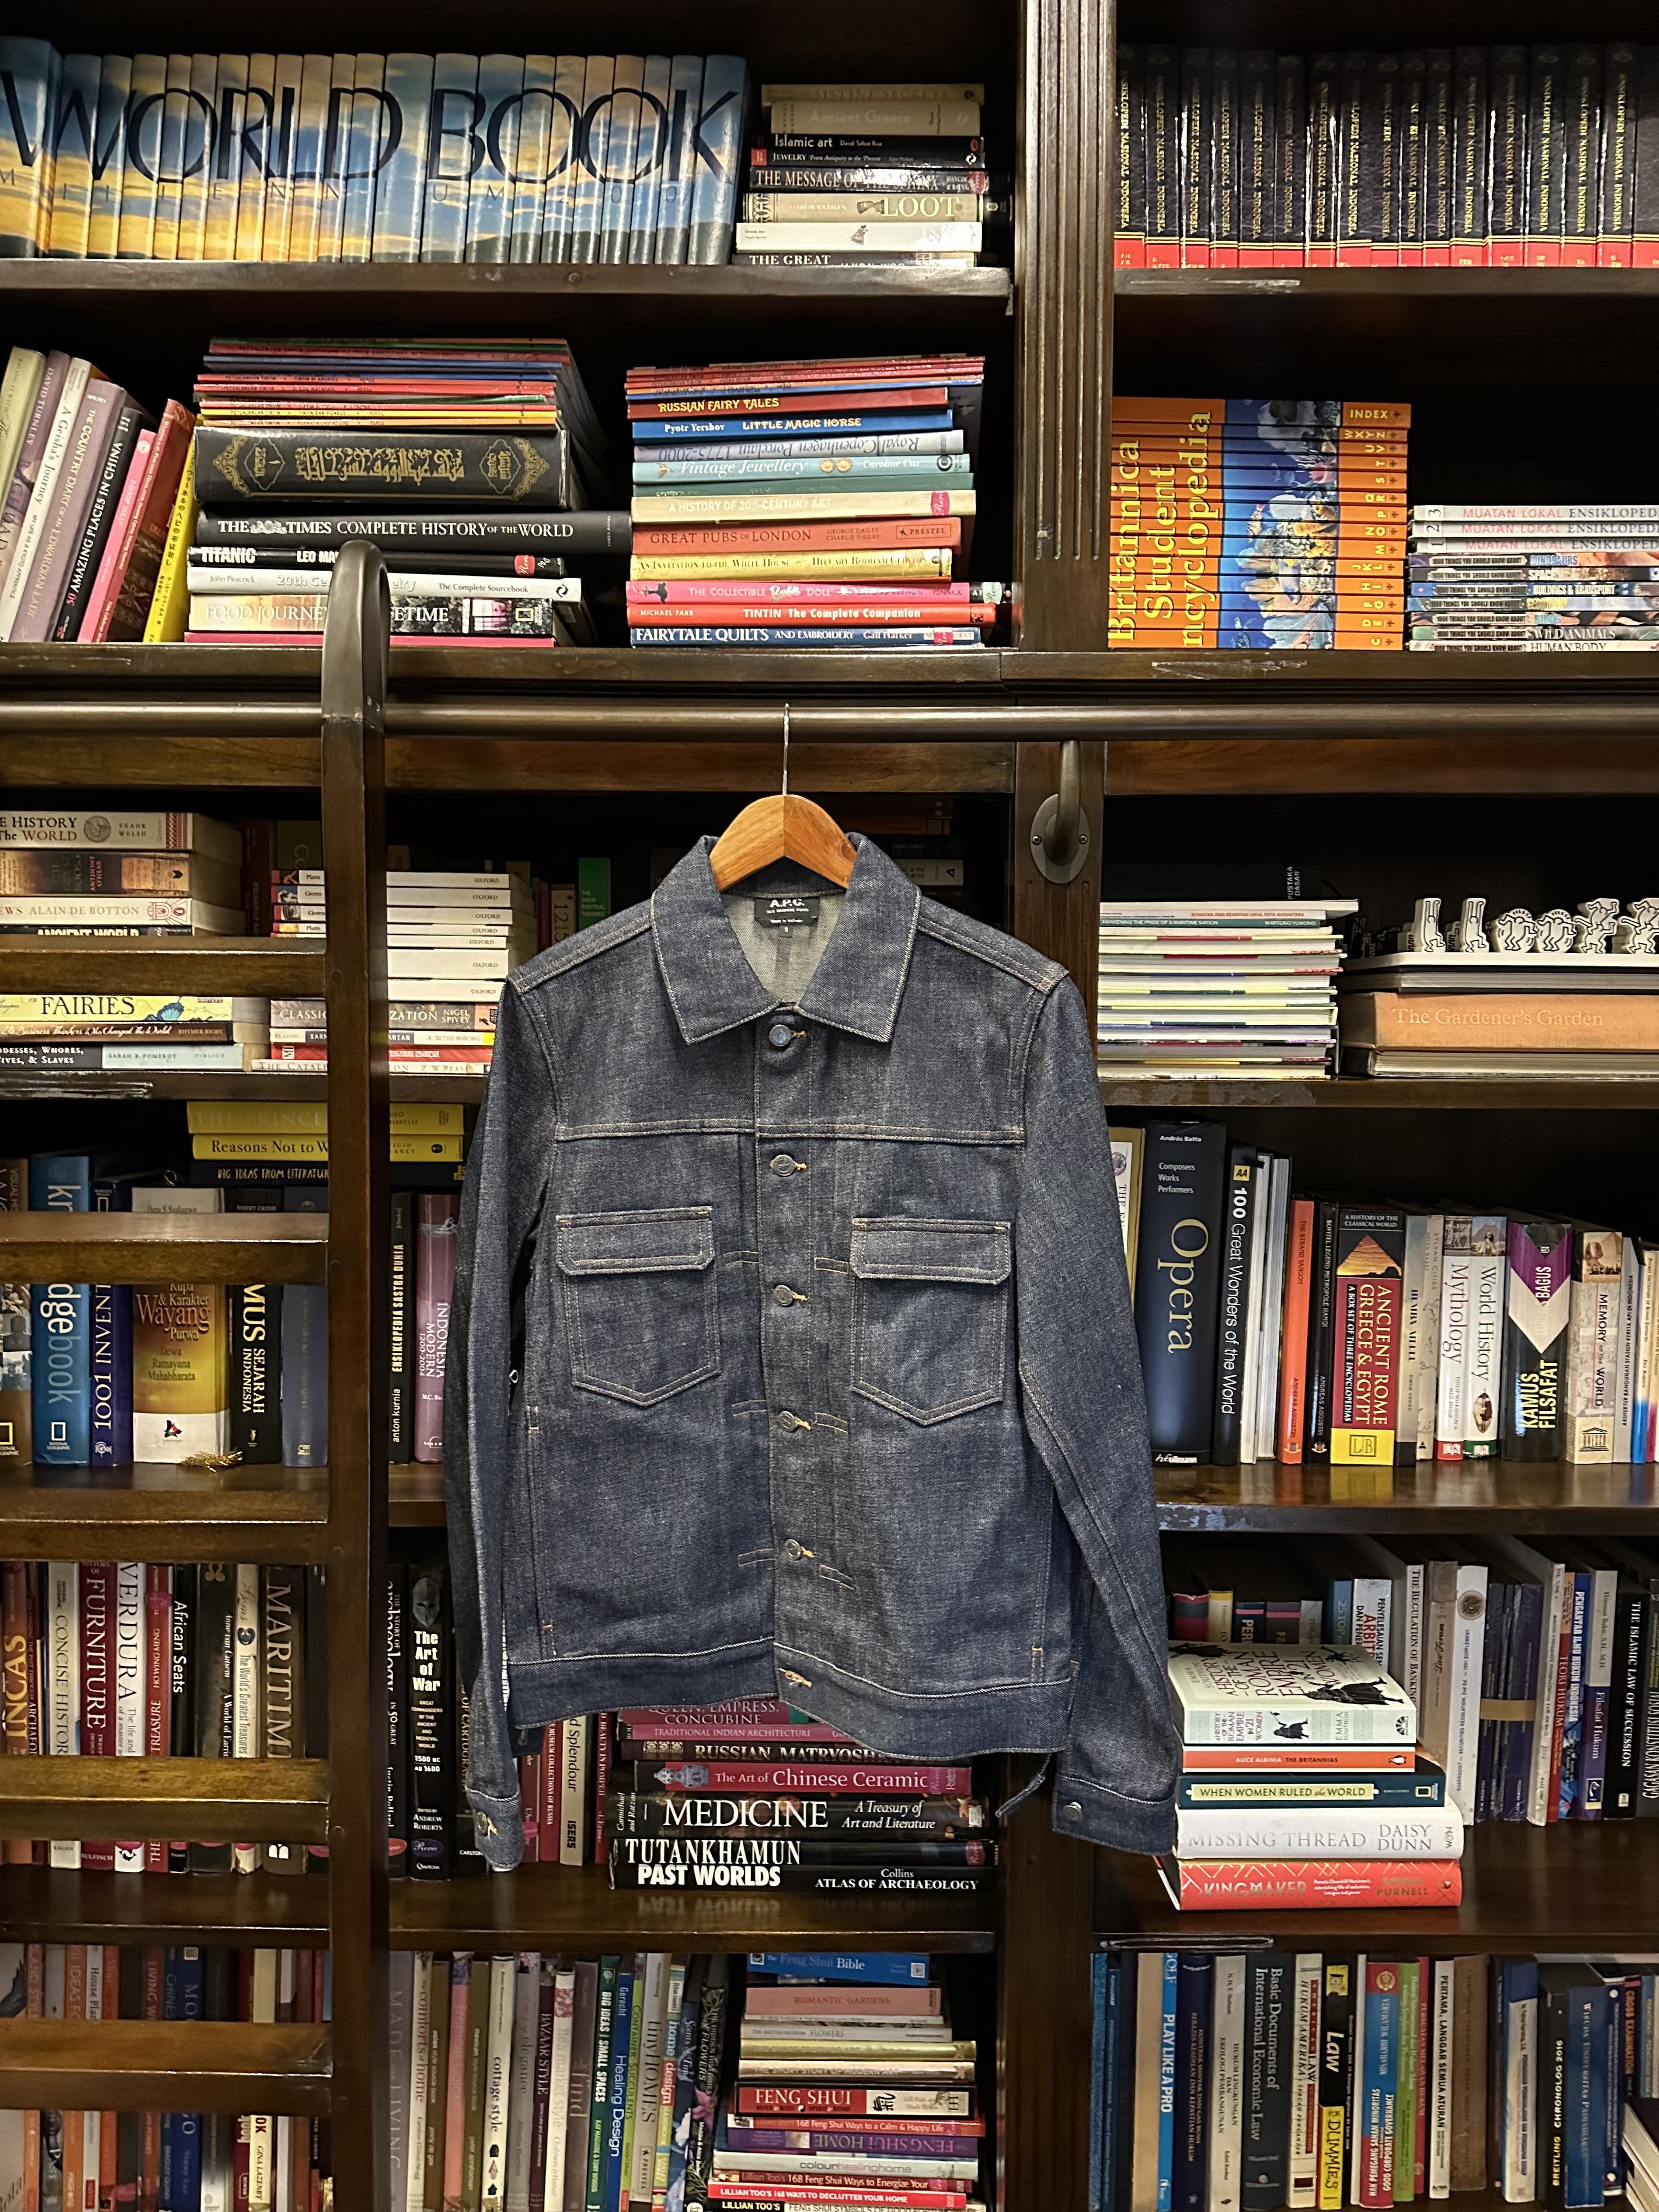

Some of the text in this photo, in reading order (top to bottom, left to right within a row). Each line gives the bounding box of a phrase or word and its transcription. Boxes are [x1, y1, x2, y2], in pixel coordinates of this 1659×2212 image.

[1, 71, 740, 185] WORLD BOOK
[775, 135, 833, 148] Islamic art
[773, 153, 806, 161] JEWELRY
[756, 170, 840, 188] THE MESSAGE
[1613, 137, 1624, 231] NASIONAL INDONESIA
[881, 197, 960, 218] LOOT
[749, 255, 831, 265] THE GREAT
[657, 398, 779, 413] RUSSIAN FAIRY TALES
[1349, 409, 1388, 419] INDEX
[665, 422, 725, 434] Pyotr Yershov
[742, 417, 862, 431] LITTLE MAGIC HORSE
[35, 407, 71, 504] A Geisha's Journey
[659, 433, 921, 462] Royal Copenhagen Porcelain 1775-2000
[680, 459, 809, 477] Vintage Jewellery
[71, 442, 123, 593] AMAZING PLACES IN CHINA
[1463, 508, 1563, 518] MUATAN LOKAL
[218, 520, 249, 533] THE
[286, 521, 332, 534] TIMES
[337, 521, 417, 536] COMPLETE
[421, 522, 487, 536] HISTORY
[518, 523, 574, 537] WORLD
[650, 533, 697, 544] GREAT
[702, 531, 738, 543] PUBS
[752, 530, 811, 542] LONDON
[1108, 440, 1139, 641] Britannica
[1144, 464, 1176, 619] Student
[200, 546, 316, 564] TITANIC LEO
[453, 583, 486, 592] Complete
[744, 608, 921, 620] TINTIN The Complete Companion
[635, 628, 712, 642] FAIRYTALE
[715, 628, 769, 642] QUILTS
[797, 630, 854, 639] EMBROIDERY
[1534, 628, 1616, 639] WILD ANIMALS
[12, 817, 77, 829] HISTORY
[22, 830, 77, 841] WORLD
[770, 899, 805, 908] A.P.C.
[41, 997, 135, 1015] FAIRIES
[1392, 1008, 1604, 1027] The Gardener's Garden
[211, 1140, 314, 1154] Reasons Not to
[1158, 1162, 1195, 1171] Composers
[1158, 1185, 1194, 1194] Performers
[1157, 1218, 1209, 1354] Opera
[1535, 1265, 1551, 1298] BAGUS
[392, 1244, 404, 1372] ENSIKLOPEDIA SASTRA DUNIA
[1221, 1187, 1248, 1414] 100 Great Wonders of the World
[136, 1293, 210, 1334] Wayang
[1441, 1263, 1469, 1364] Mythology
[1471, 1265, 1497, 1381] World History
[1355, 1284, 1375, 1425] GREECE & EGYPT
[1373, 1285, 1392, 1425] ANCIENT ROME
[242, 1348, 252, 1413] INDONESIA
[253, 1348, 265, 1413] SEJARAH
[93, 1373, 112, 1430] 1001
[1520, 1373, 1539, 1429] KAMUS
[1538, 1360, 1558, 1429] FILSAFAT
[118, 1564, 138, 1699] VERDURA
[413, 1631, 438, 1645] The
[86, 1578, 106, 1729] FURNITURE
[173, 1601, 188, 1693] African Seats
[415, 1648, 438, 1660] Art
[419, 1663, 433, 1676] of
[5, 1635, 27, 1739] INCAS
[413, 1678, 440, 1692] War
[714, 1773, 736, 1784] The
[738, 1773, 756, 1783] Art
[757, 1772, 769, 1783] of
[773, 1770, 847, 1788] Chinese
[1200, 1788, 1232, 1797] WHEN
[1235, 1788, 1277, 1796] WOMEN
[1279, 1787, 1311, 1796] RULED
[1327, 1787, 1366, 1796] WORLD
[662, 1800, 829, 1829] MEDICINE
[1283, 1833, 1367, 1847] THREAD
[1379, 1824, 1433, 1838] DAISY
[625, 1839, 801, 1866] TUTANKHAMUN
[1377, 1838, 1432, 1850] DUNN
[638, 1865, 781, 1887] PAST WORLDS
[881, 1869, 914, 1878] Collins
[815, 1879, 979, 1890] ATLAS OF ARCHAEOLOGY
[837, 1956, 865, 1971] Bible
[794, 1996, 891, 2005] ROMANTIC GARDENS
[1326, 2031, 1344, 2072] Law
[1161, 2014, 1175, 2112] PLAY LIKE A PRO
[488, 2057, 503, 2132] cottage style
[755, 2089, 851, 2105] FENG SHUI
[609, 2055, 627, 2157] Healing Design
[1325, 2119, 1340, 2188] DUMMIES
